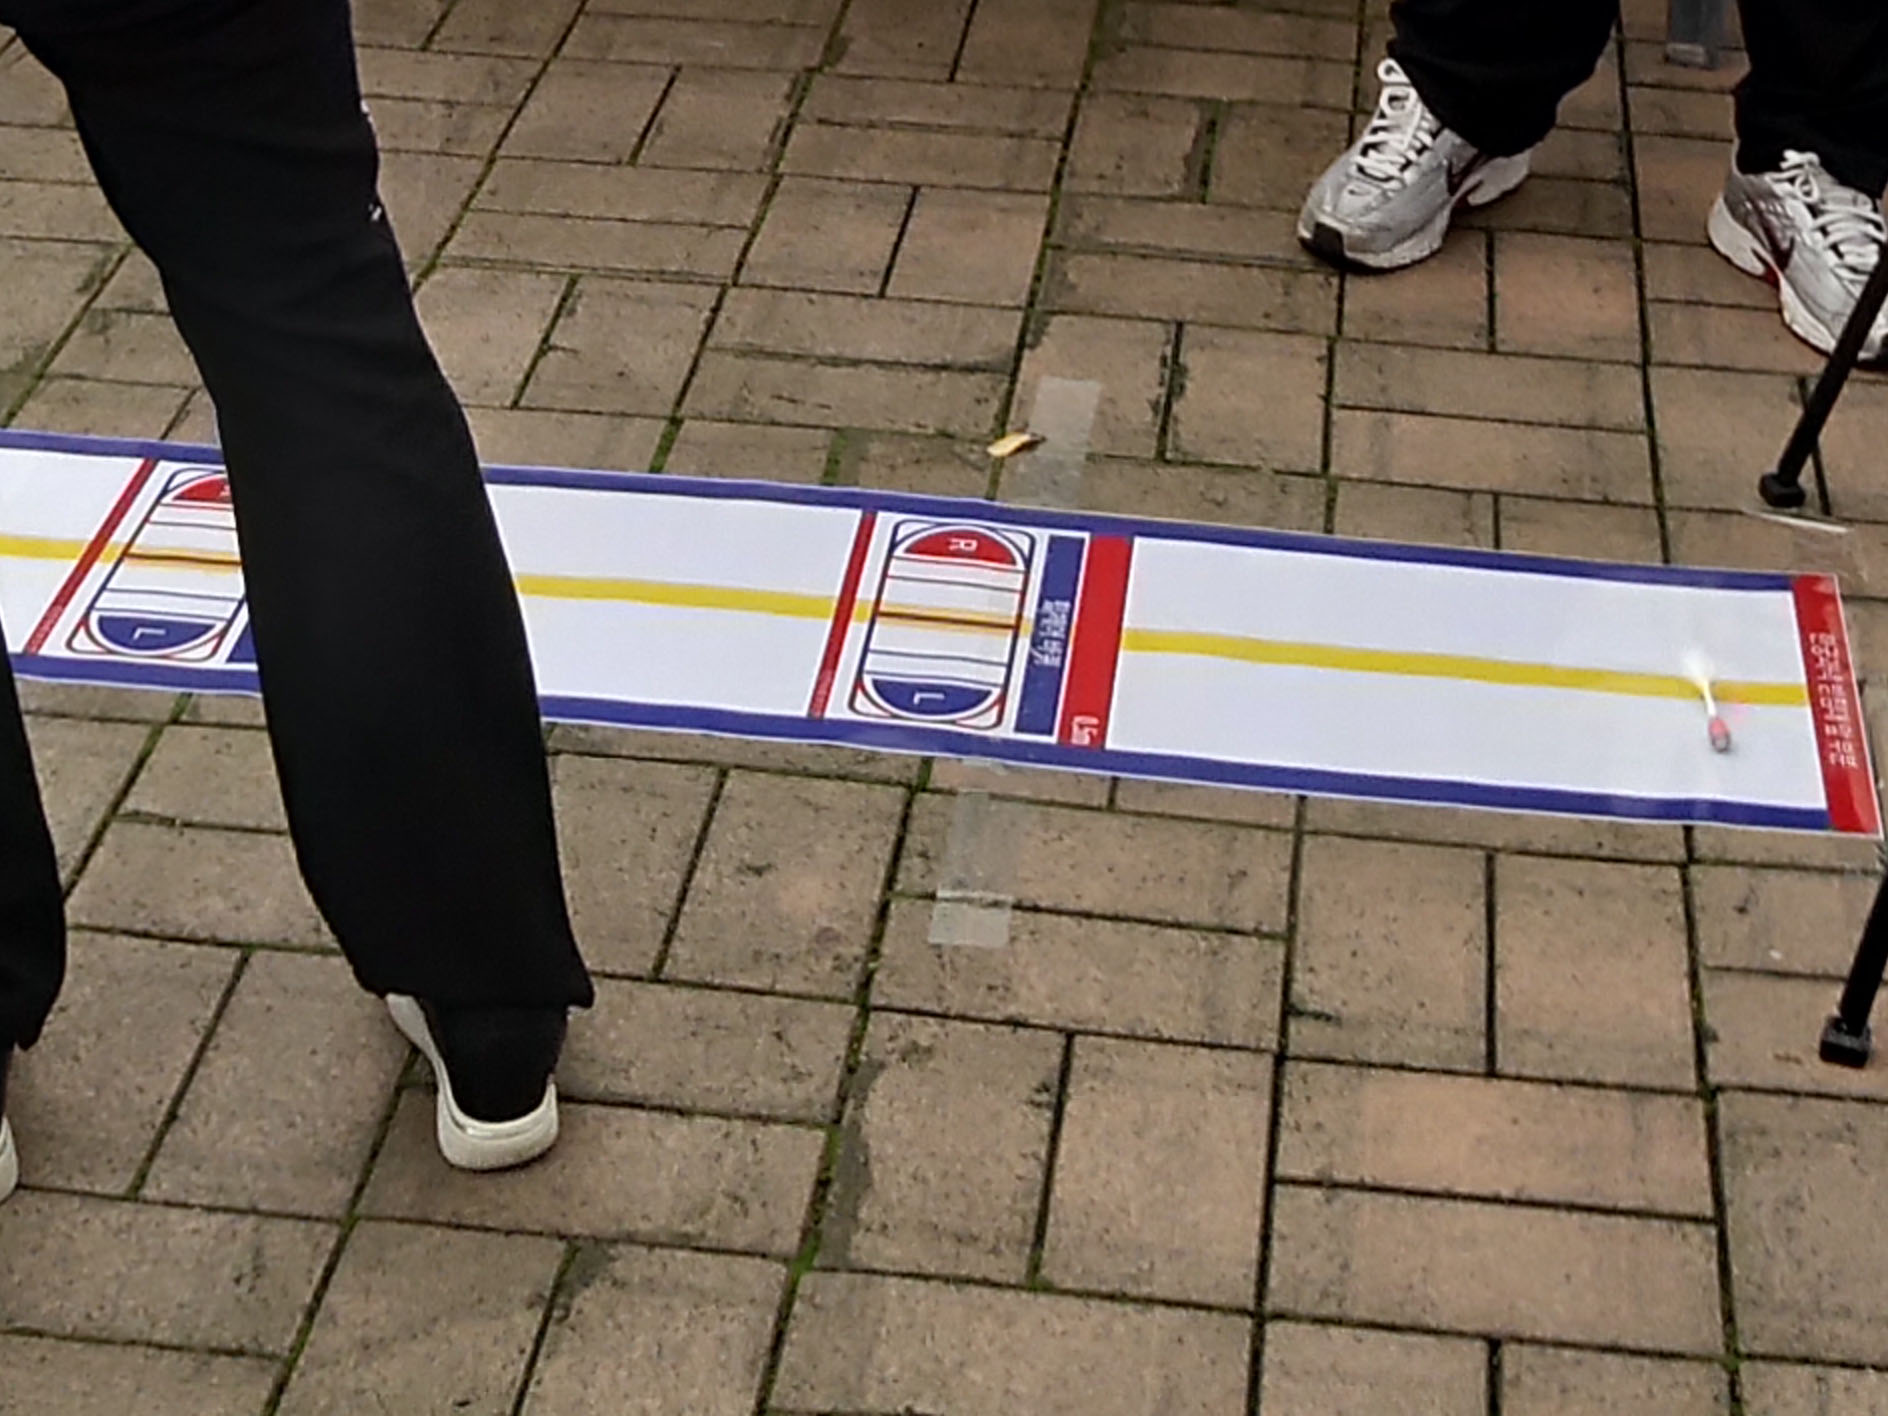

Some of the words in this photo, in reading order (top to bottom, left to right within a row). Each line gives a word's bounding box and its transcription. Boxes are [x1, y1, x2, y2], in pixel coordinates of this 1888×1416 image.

[948, 537, 978, 553] R
[132, 627, 166, 641] L
[913, 691, 945, 705] L
